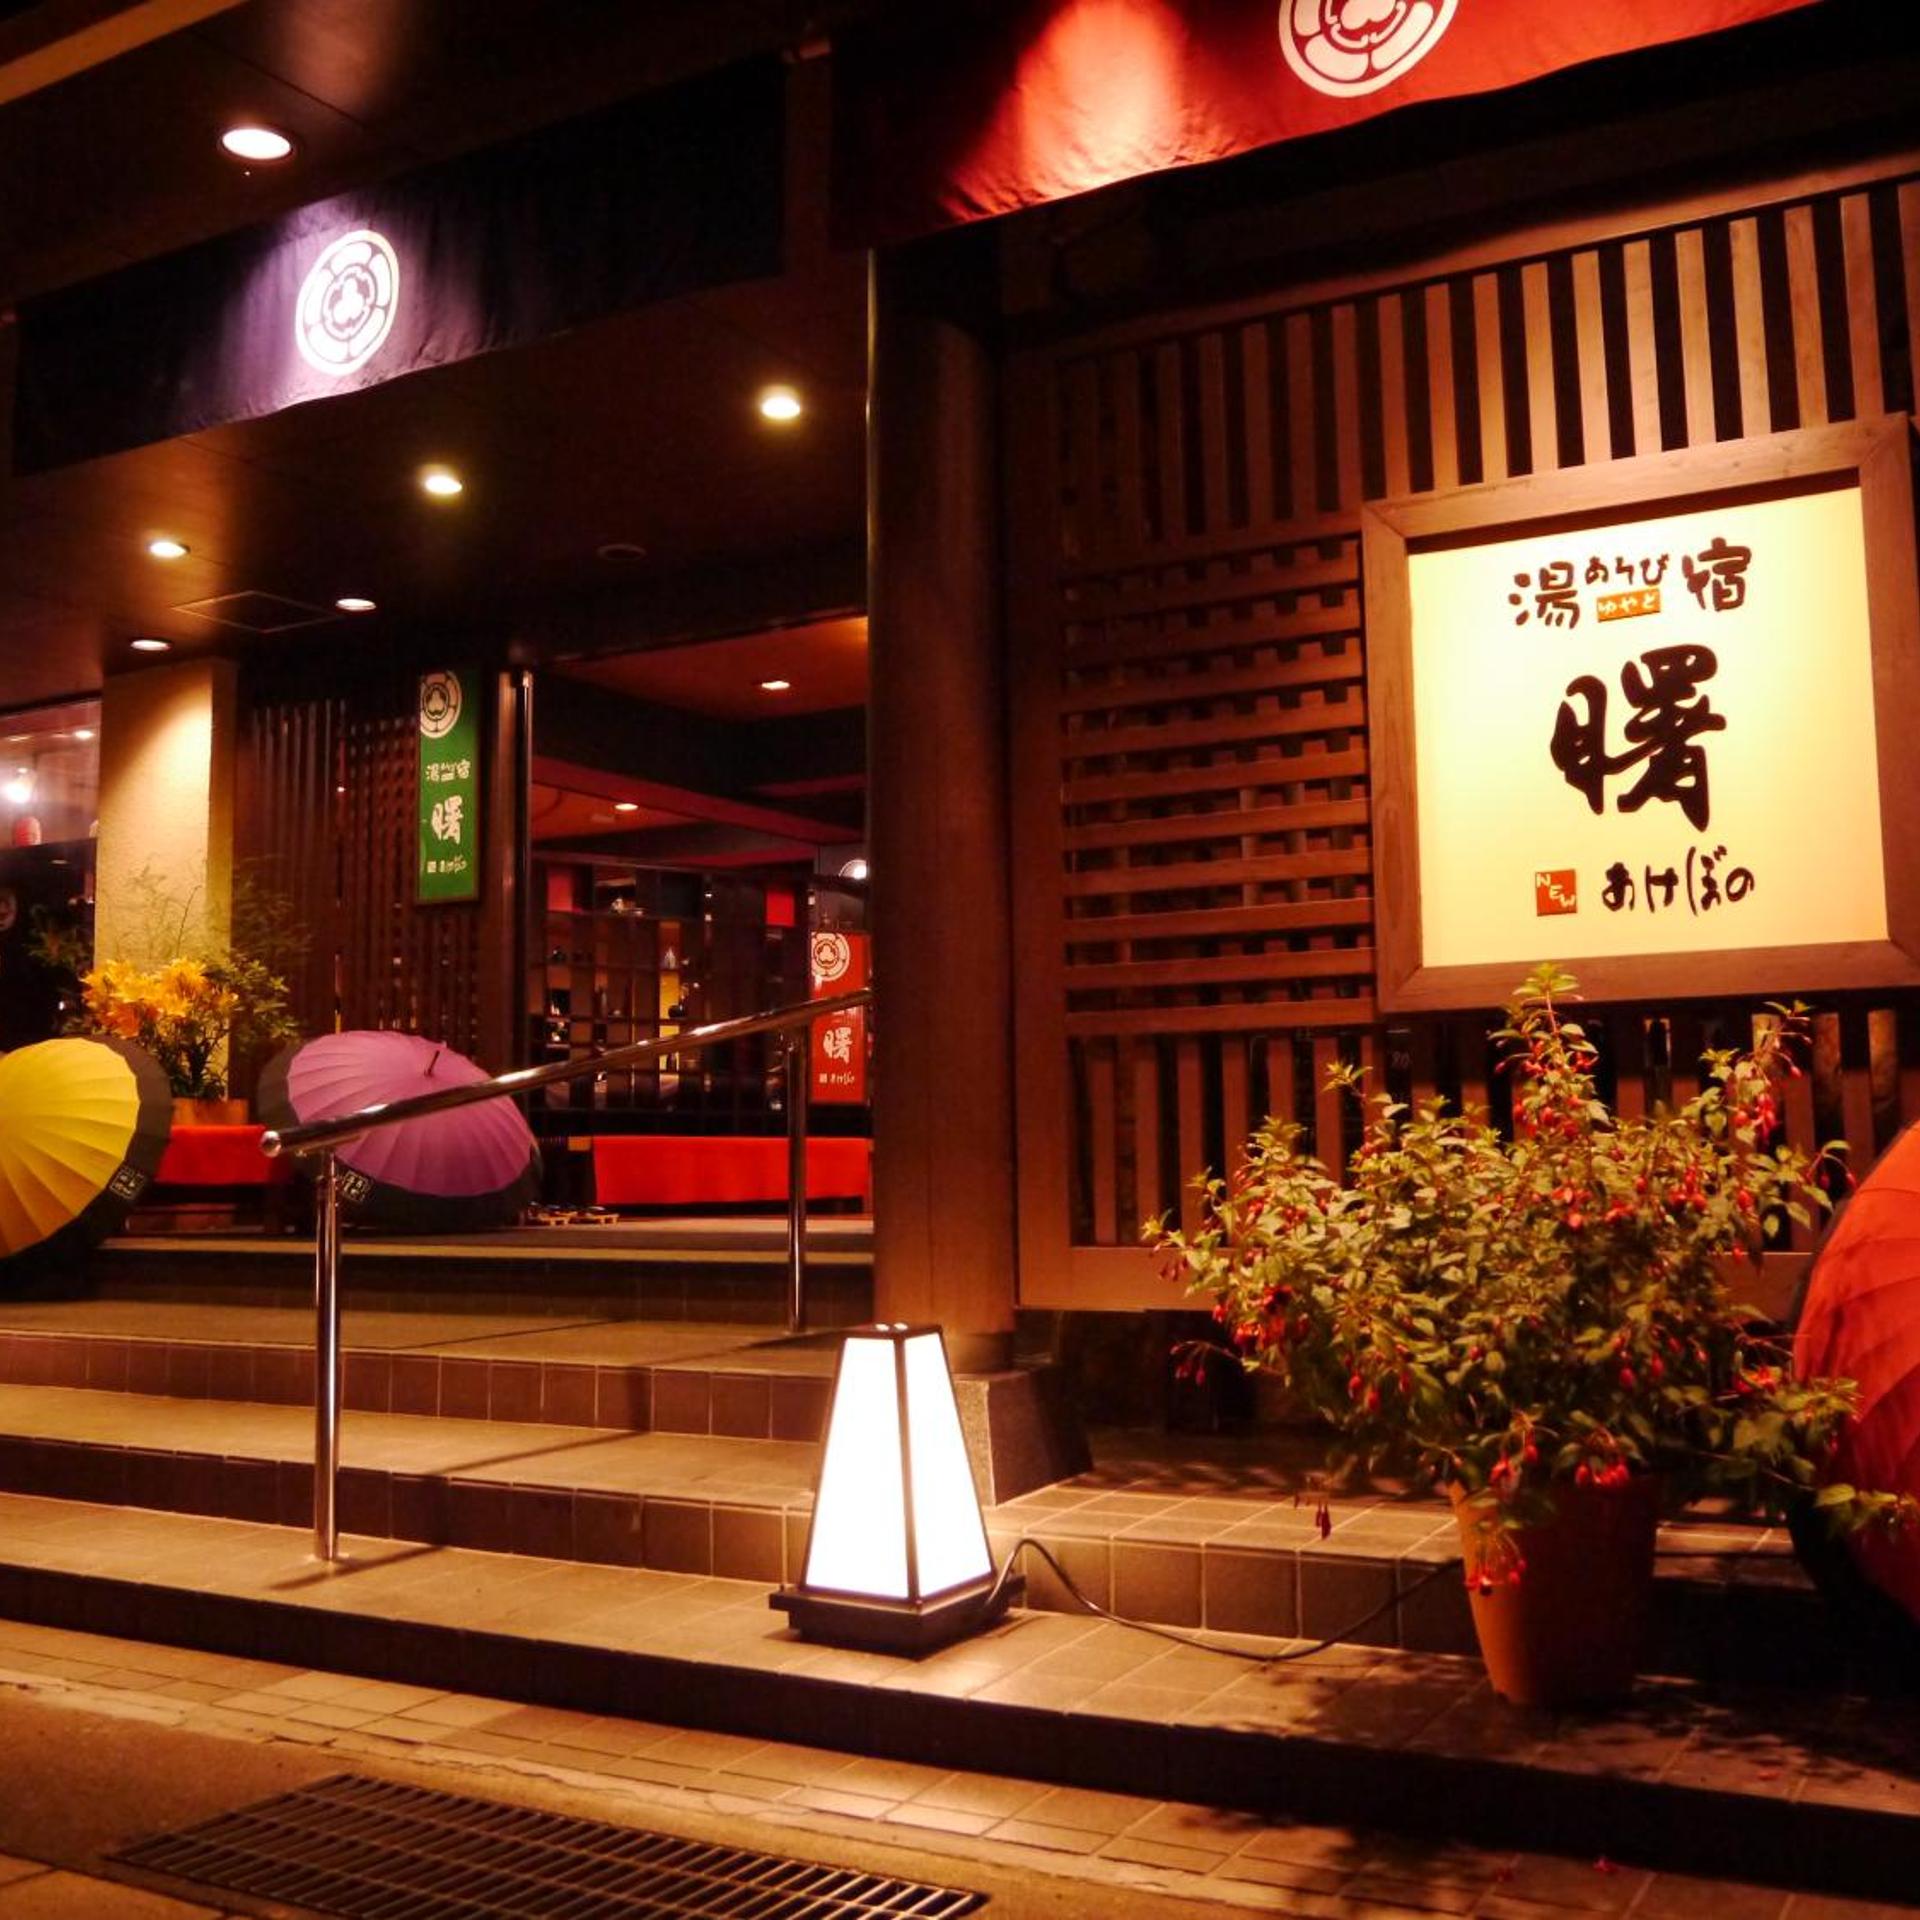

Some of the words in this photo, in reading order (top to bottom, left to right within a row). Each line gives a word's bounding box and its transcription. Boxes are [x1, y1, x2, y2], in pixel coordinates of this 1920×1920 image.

[1551, 644, 1727, 832] 曙
[1536, 873, 1576, 908] NEW
[1602, 845, 1755, 916] あけぼの
